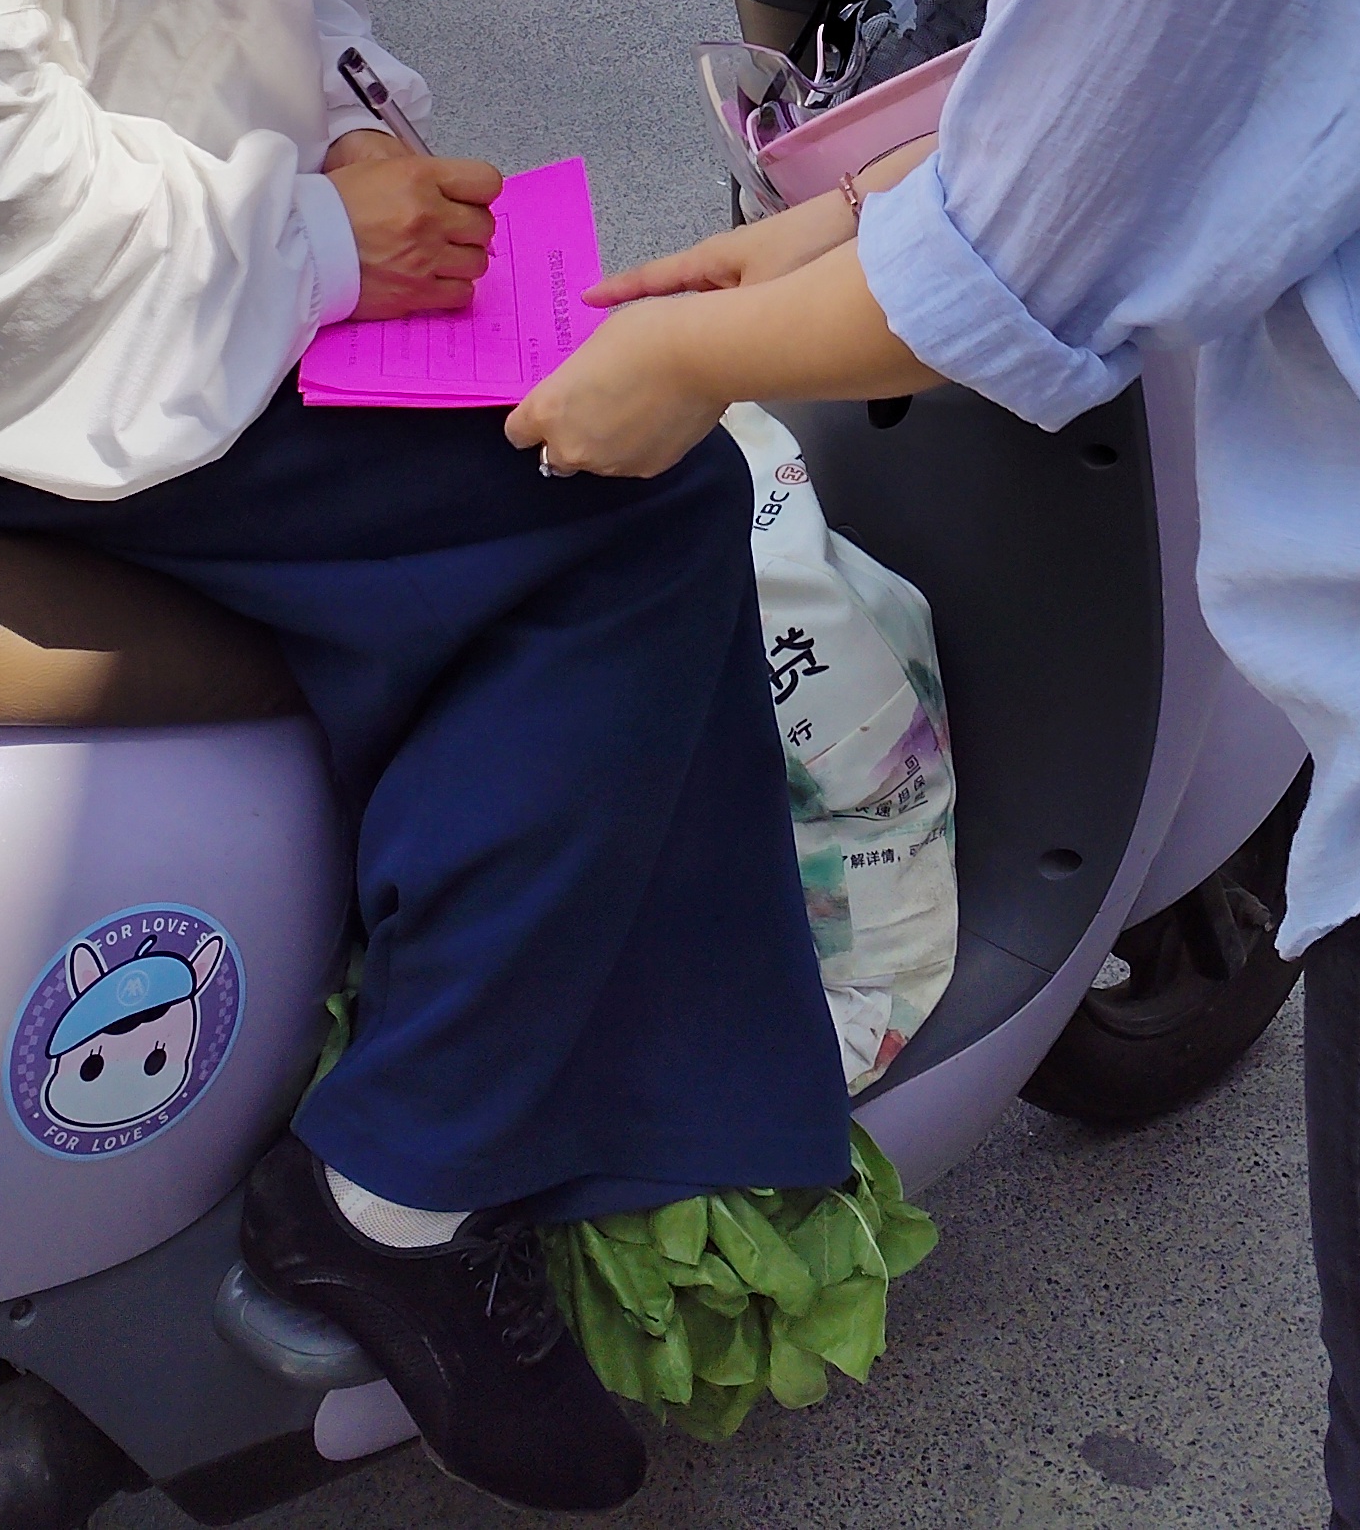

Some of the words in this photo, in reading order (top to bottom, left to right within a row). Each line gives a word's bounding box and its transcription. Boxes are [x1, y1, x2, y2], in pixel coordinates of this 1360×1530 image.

[753, 490, 790, 531] ICBC
[787, 718, 813, 747] 行
[43, 1124, 80, 1151] FOR
